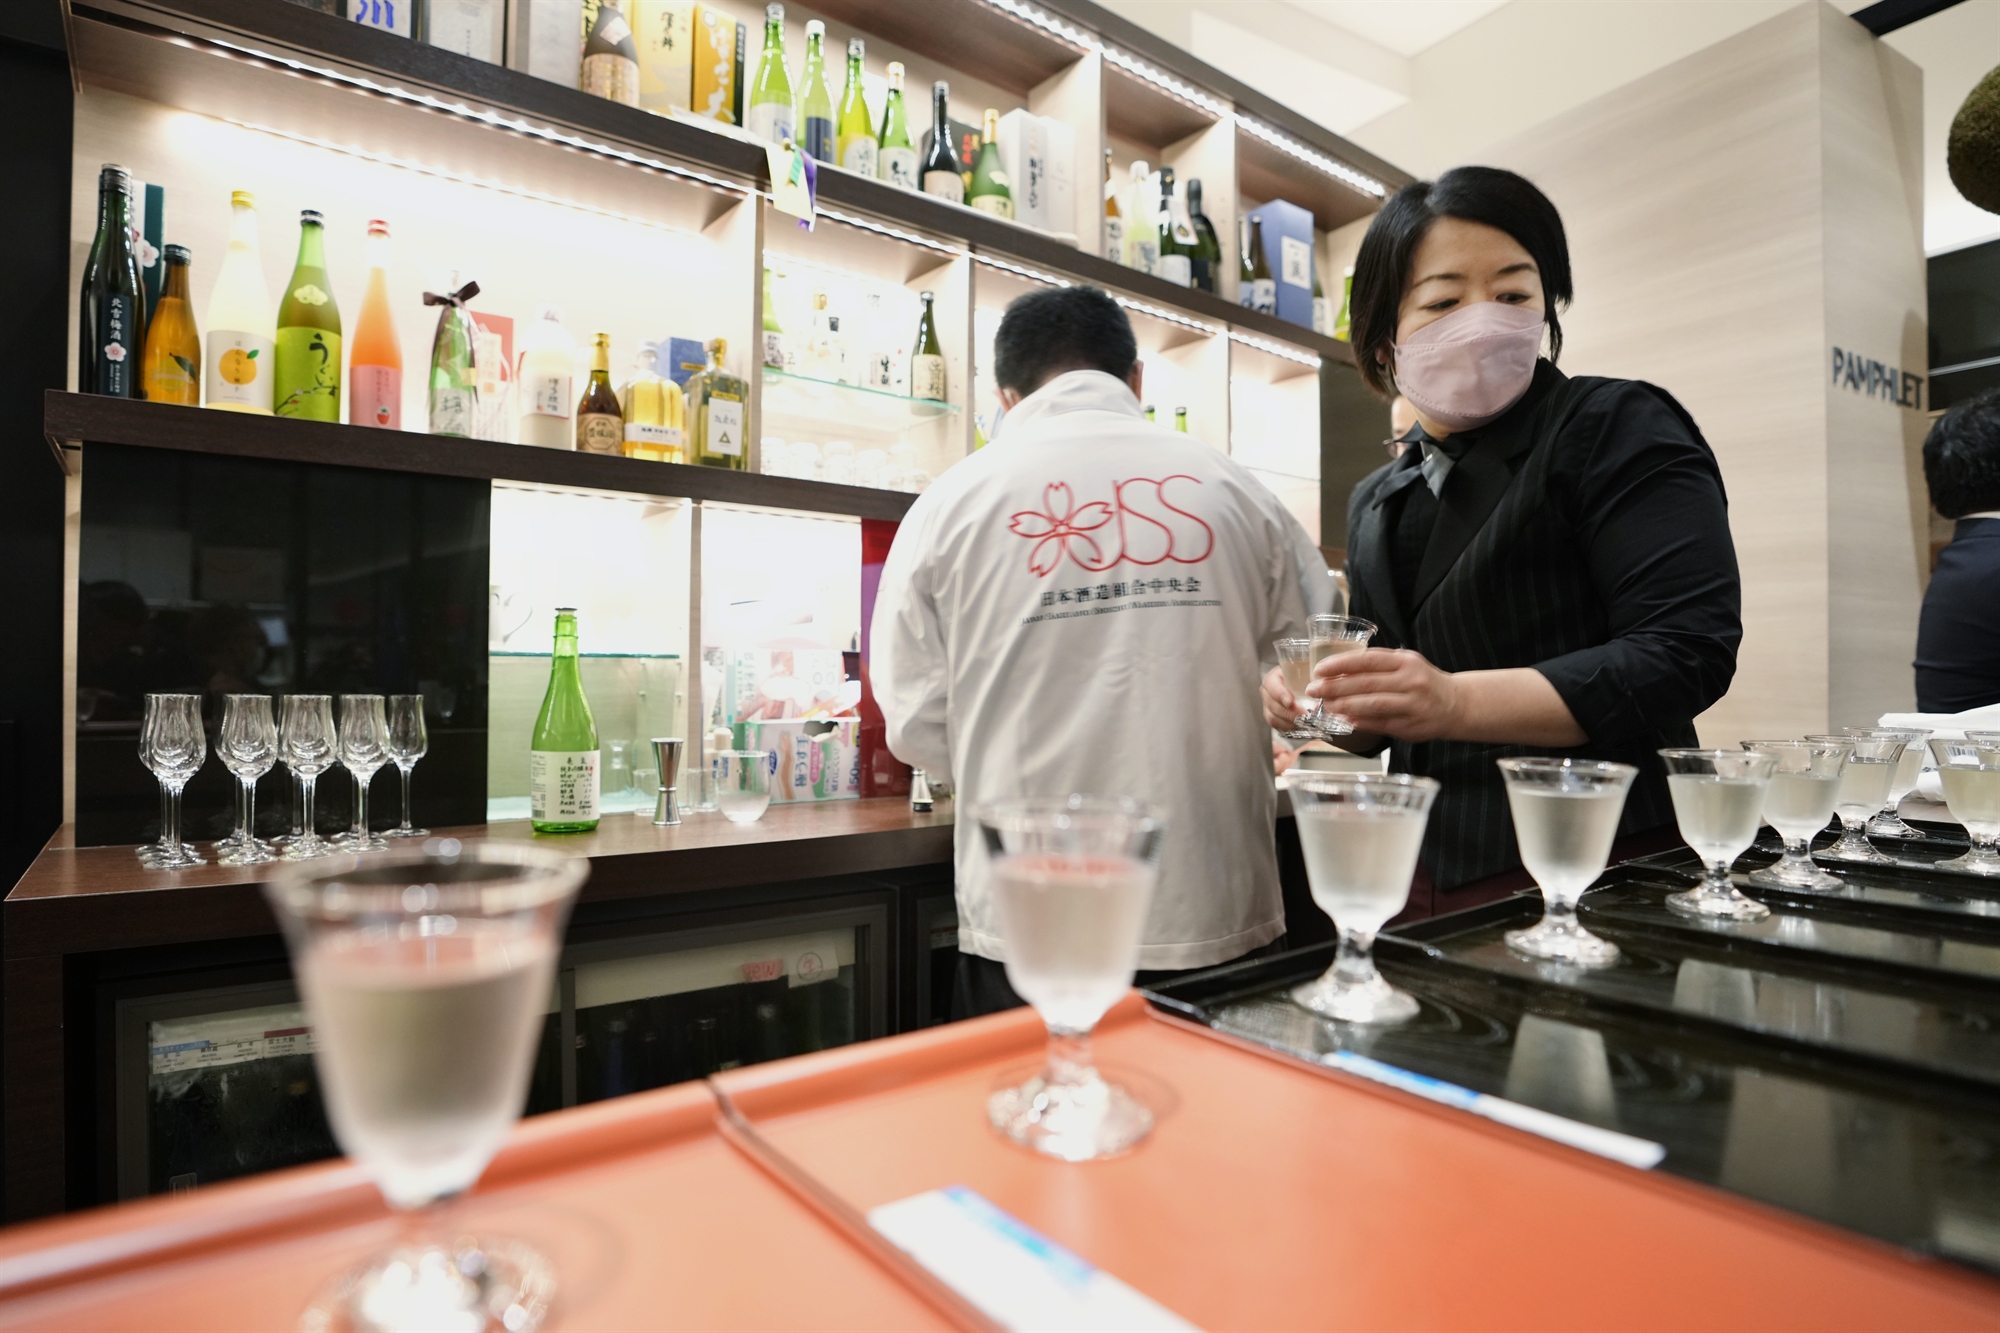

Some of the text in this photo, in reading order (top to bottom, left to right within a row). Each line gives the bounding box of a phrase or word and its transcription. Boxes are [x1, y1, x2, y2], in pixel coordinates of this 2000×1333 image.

[110, 297, 122, 341] 北雪梅酒
[1832, 346, 1924, 411] PAMPHLET
[1040, 577, 1202, 607] 日本酒造組合中央会
[794, 736, 809, 787] 極うす手
